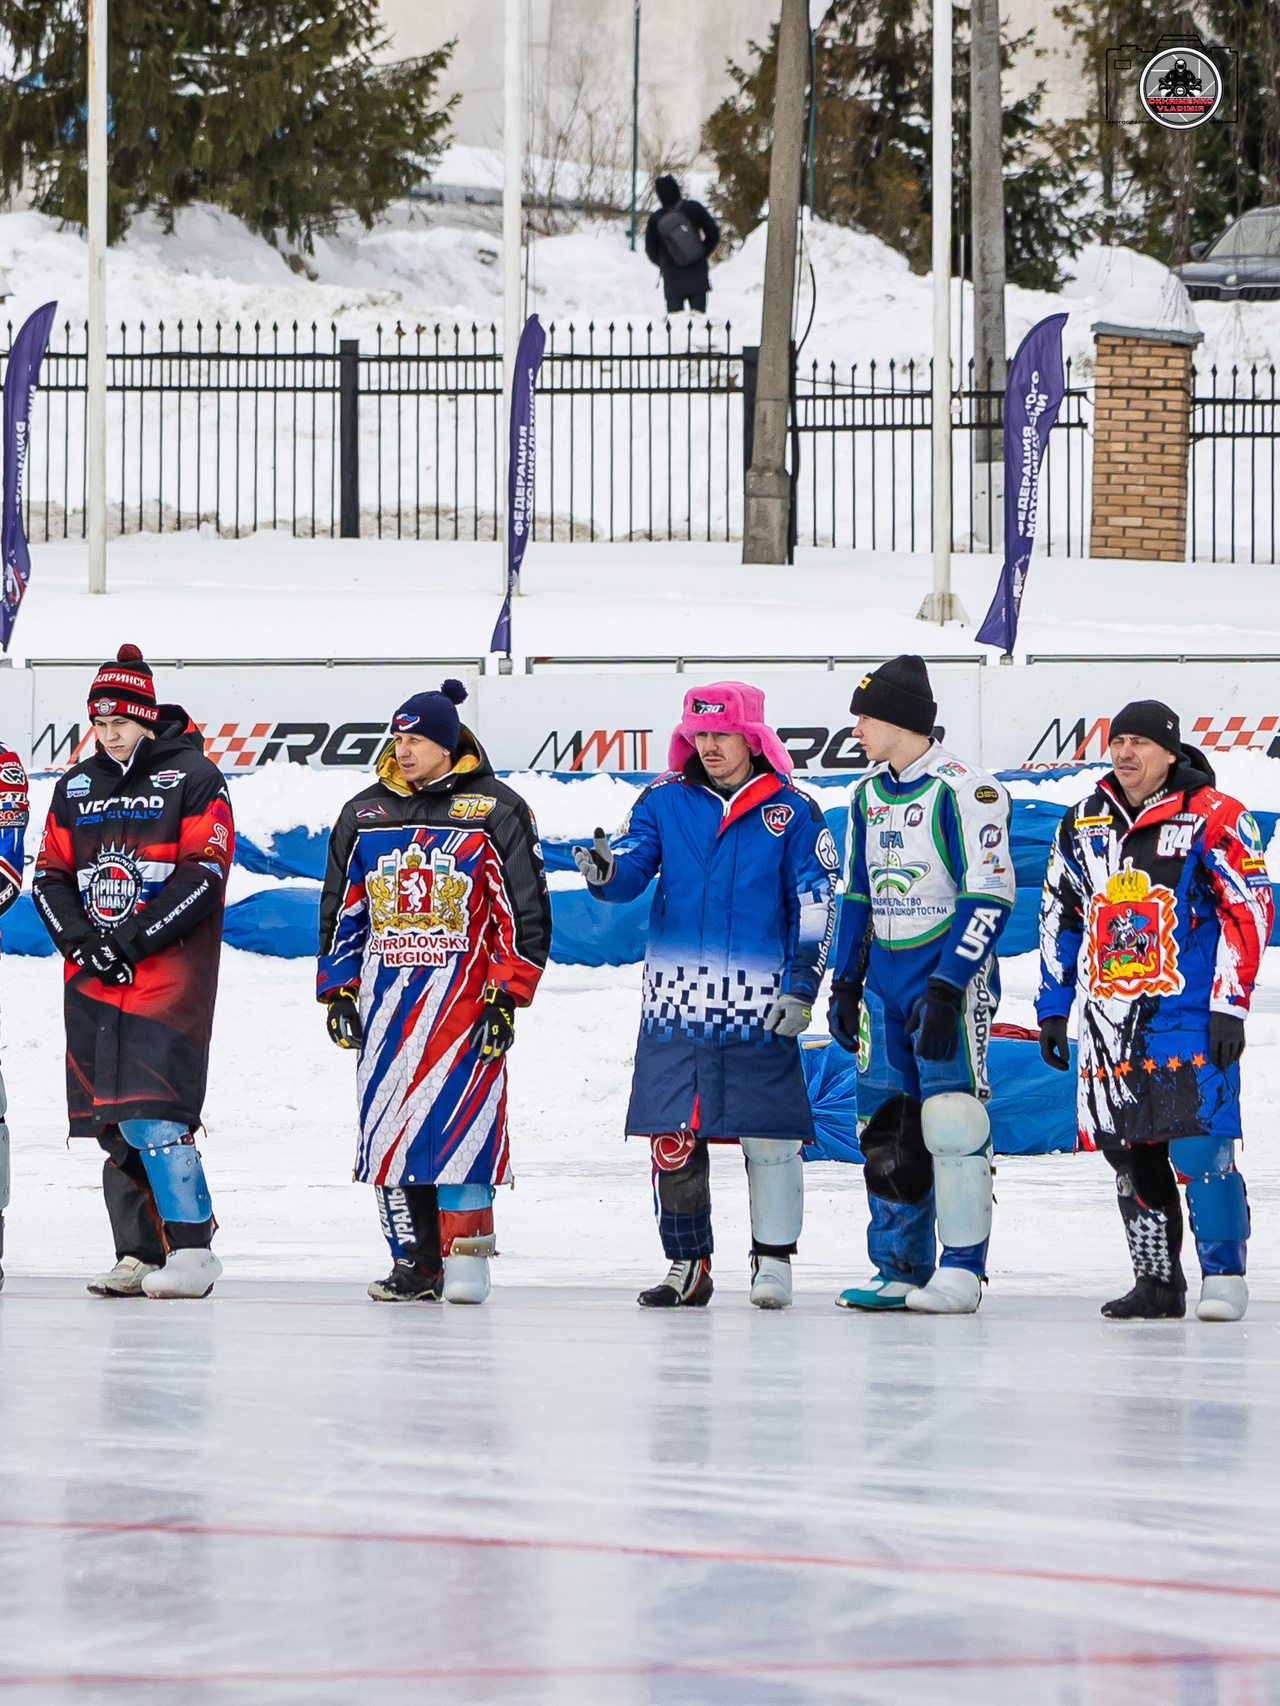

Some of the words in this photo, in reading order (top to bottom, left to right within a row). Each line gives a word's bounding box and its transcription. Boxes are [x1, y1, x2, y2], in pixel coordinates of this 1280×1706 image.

[513, 426, 527, 537] ФЕДЕРАЦИЯ
[127, 703, 158, 721] ШААЗ
[450, 799, 495, 819] 919
[879, 831, 904, 849] UFA
[1156, 824, 1194, 858] 84
[145, 922, 163, 937] ICE
[163, 879, 211, 924] SPEEDWAY
[955, 907, 1003, 962] UFA
[385, 951, 445, 965] REGION
